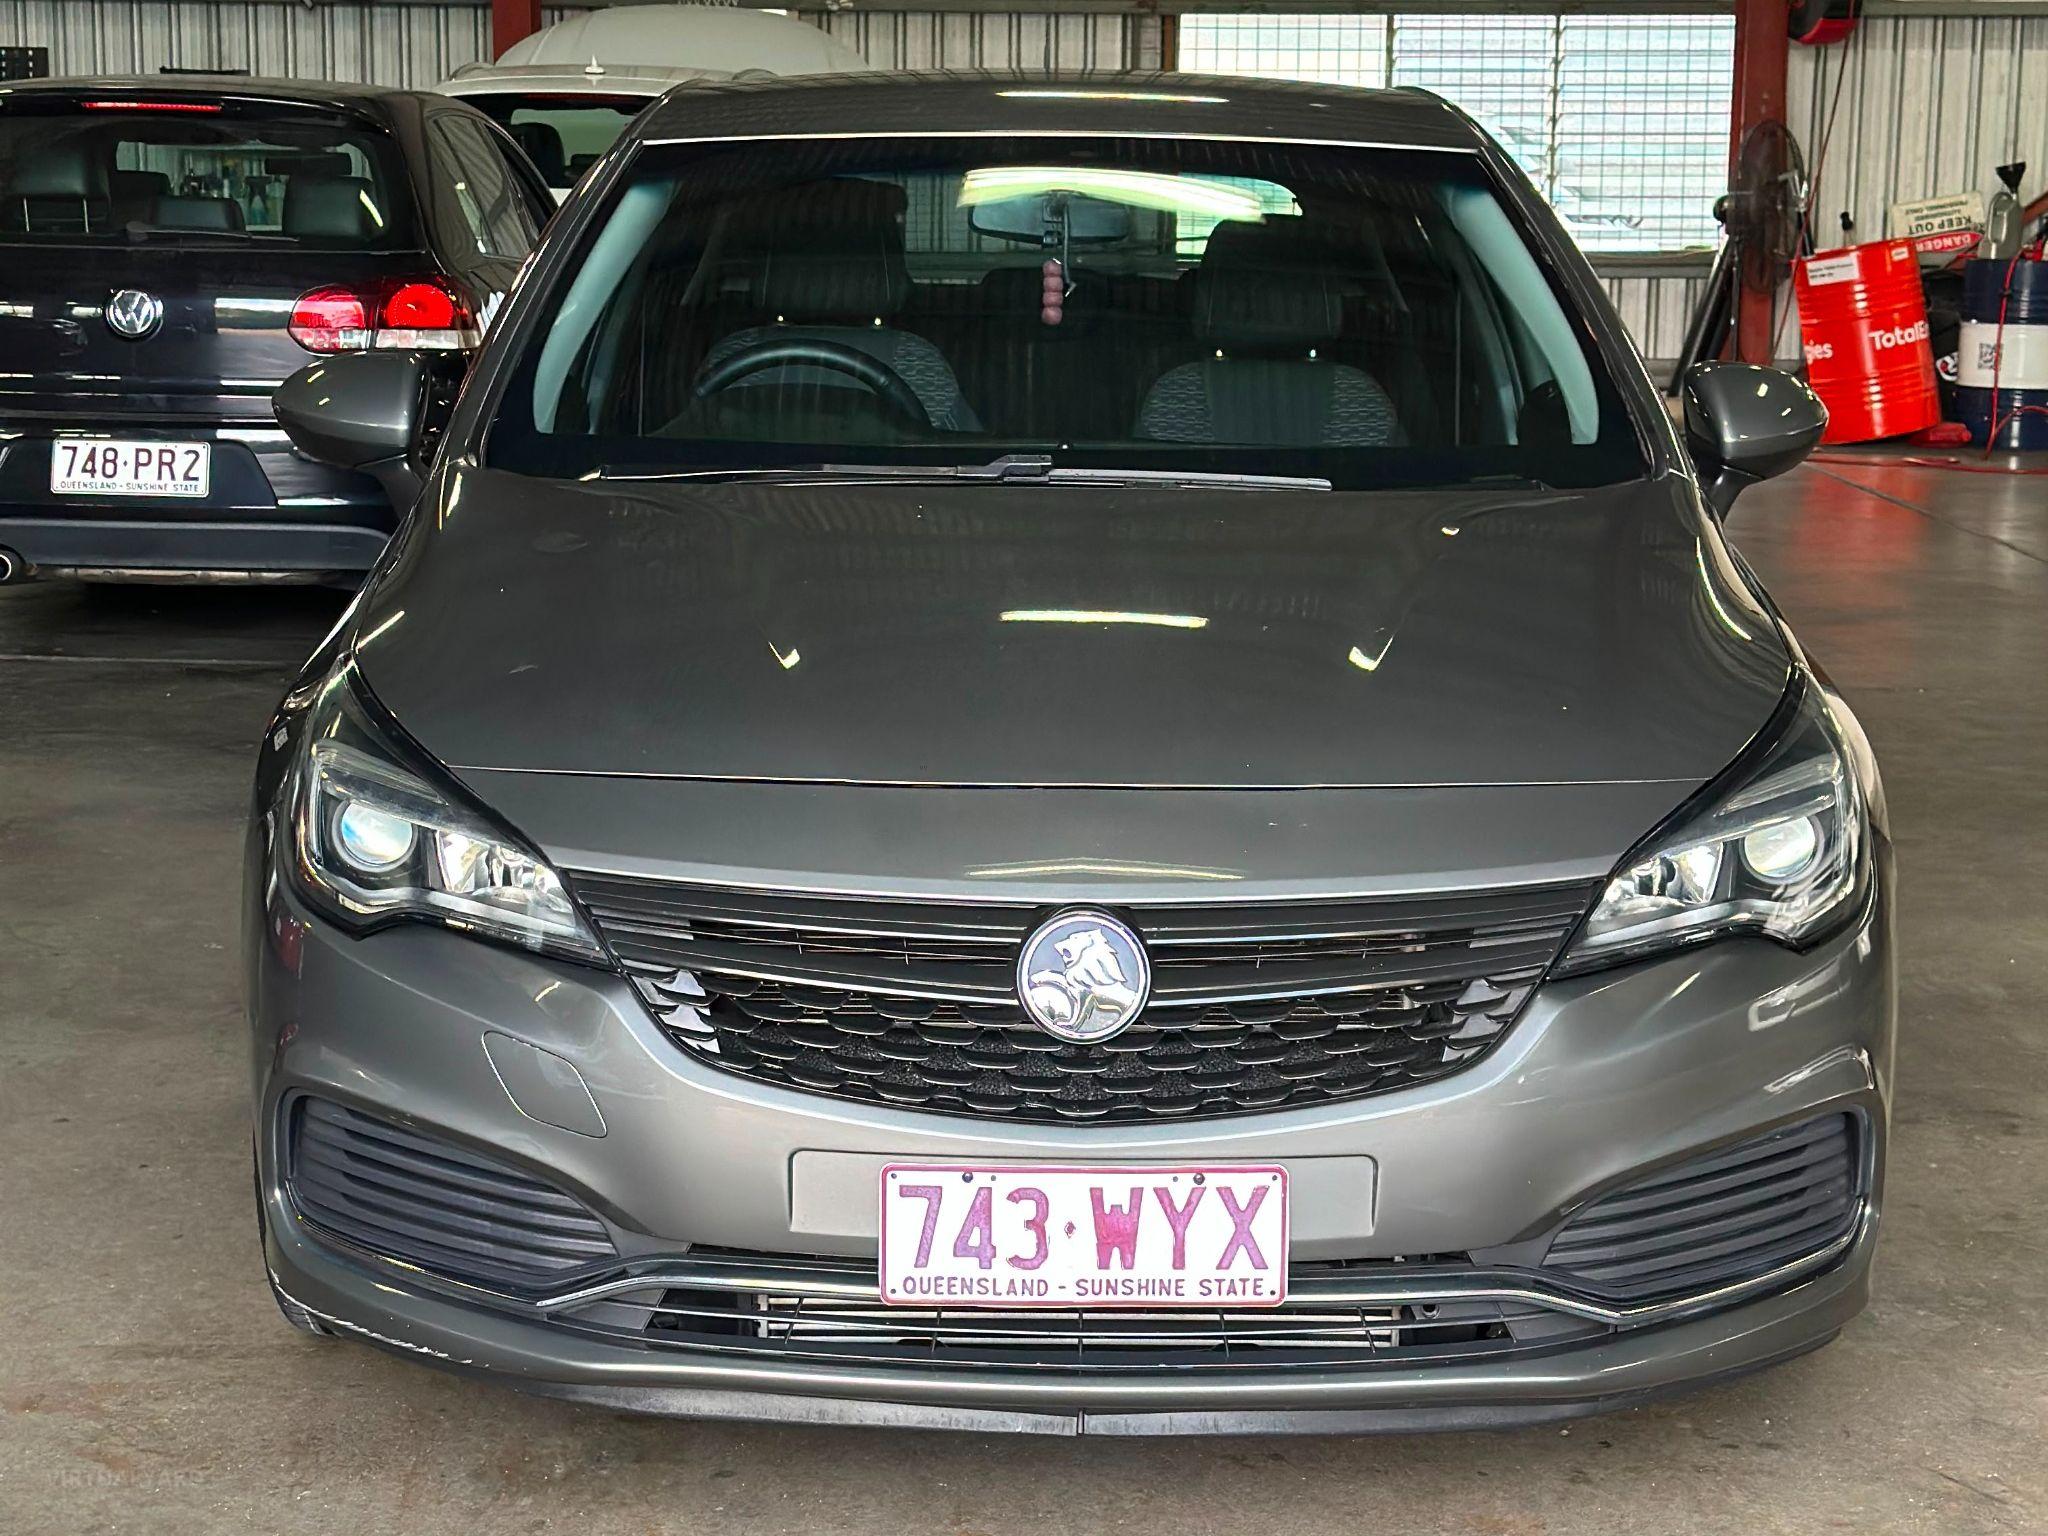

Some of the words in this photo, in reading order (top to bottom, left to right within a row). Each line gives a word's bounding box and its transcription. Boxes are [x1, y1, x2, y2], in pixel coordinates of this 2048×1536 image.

[1908, 222, 1934, 235] OUT
[1938, 216, 1972, 230] KEEP
[1915, 234, 1971, 252] DANGER
[60, 480, 117, 490] QUEENSLAND
[126, 482, 168, 491] SUNSHINE
[173, 484, 199, 492] STATE
[902, 1276, 1050, 1297] QUEENSLAND
[1075, 1277, 1186, 1297] SUNSHINE
[1199, 1278, 1265, 1297] STATE
